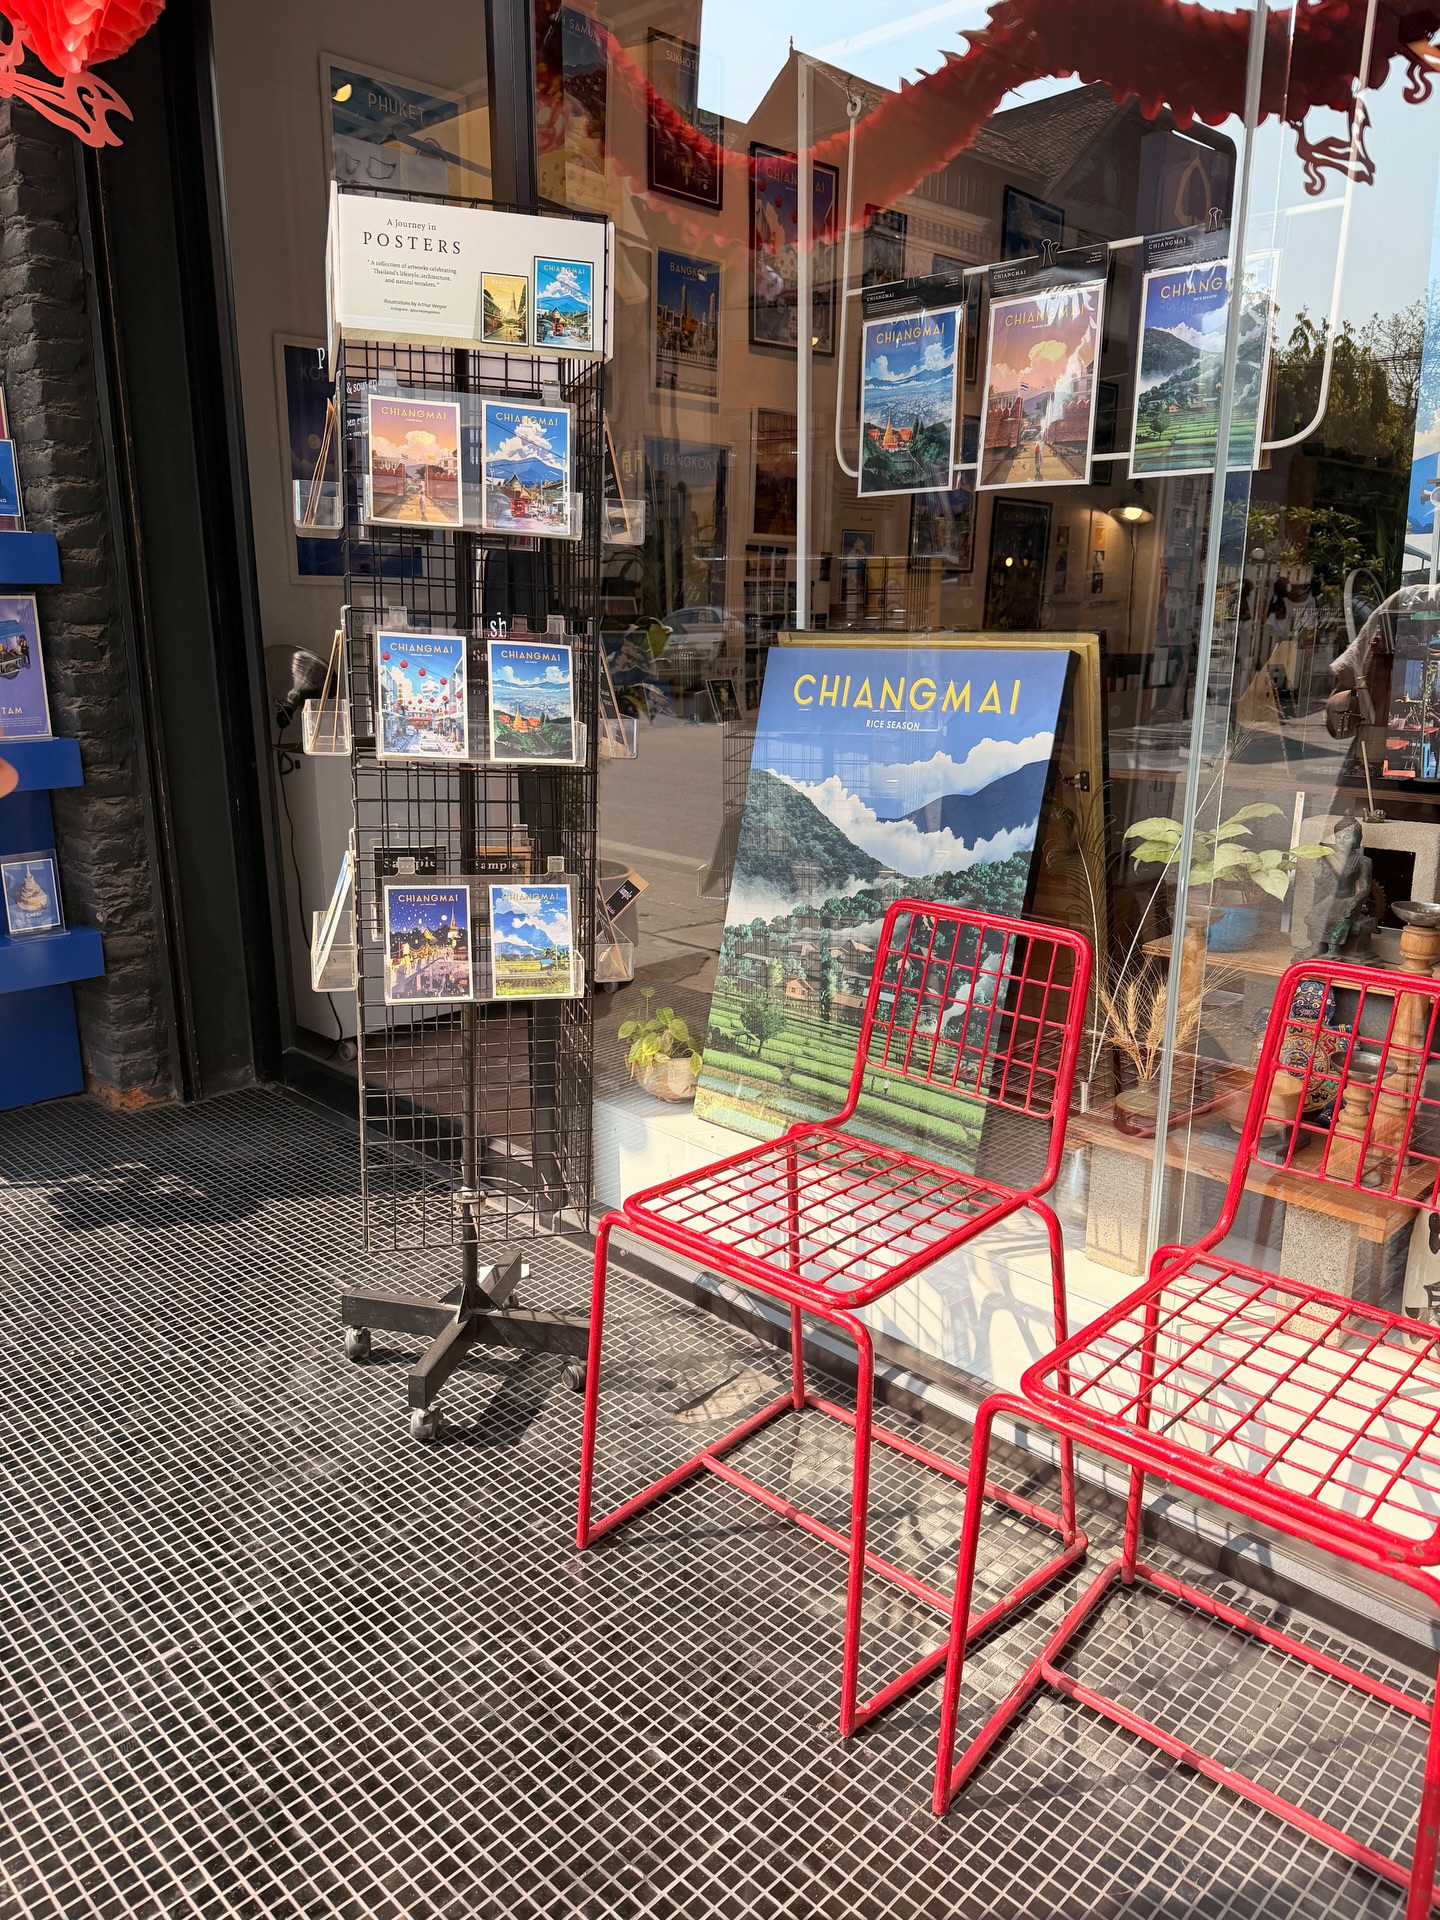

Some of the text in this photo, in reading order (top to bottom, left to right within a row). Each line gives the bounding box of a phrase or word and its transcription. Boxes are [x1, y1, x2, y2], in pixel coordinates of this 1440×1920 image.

[368, 92, 425, 123] PHUKET
[766, 166, 825, 194] CHIANAI
[387, 218, 437, 231] A Journey in
[363, 231, 461, 255] POSTERS
[376, 260, 400, 268] collection
[429, 266, 457, 275] celebrating
[543, 264, 585, 275] CHIANGMAI
[876, 322, 945, 344] CHIANGMAI
[381, 406, 447, 420] CHIANGMAI
[495, 412, 558, 426] CHIANGMAI
[662, 453, 712, 471] BANGKOK
[389, 642, 453, 654] CHIANGMAI
[500, 649, 561, 662] CHIANGMAI
[793, 674, 1021, 715] CHIANGMAI
[0, 706, 23, 715] TAM
[865, 719, 920, 731] RICE SEASON
[398, 894, 459, 903] CHIANGMAI
[501, 892, 559, 901] CHIANGMAI
